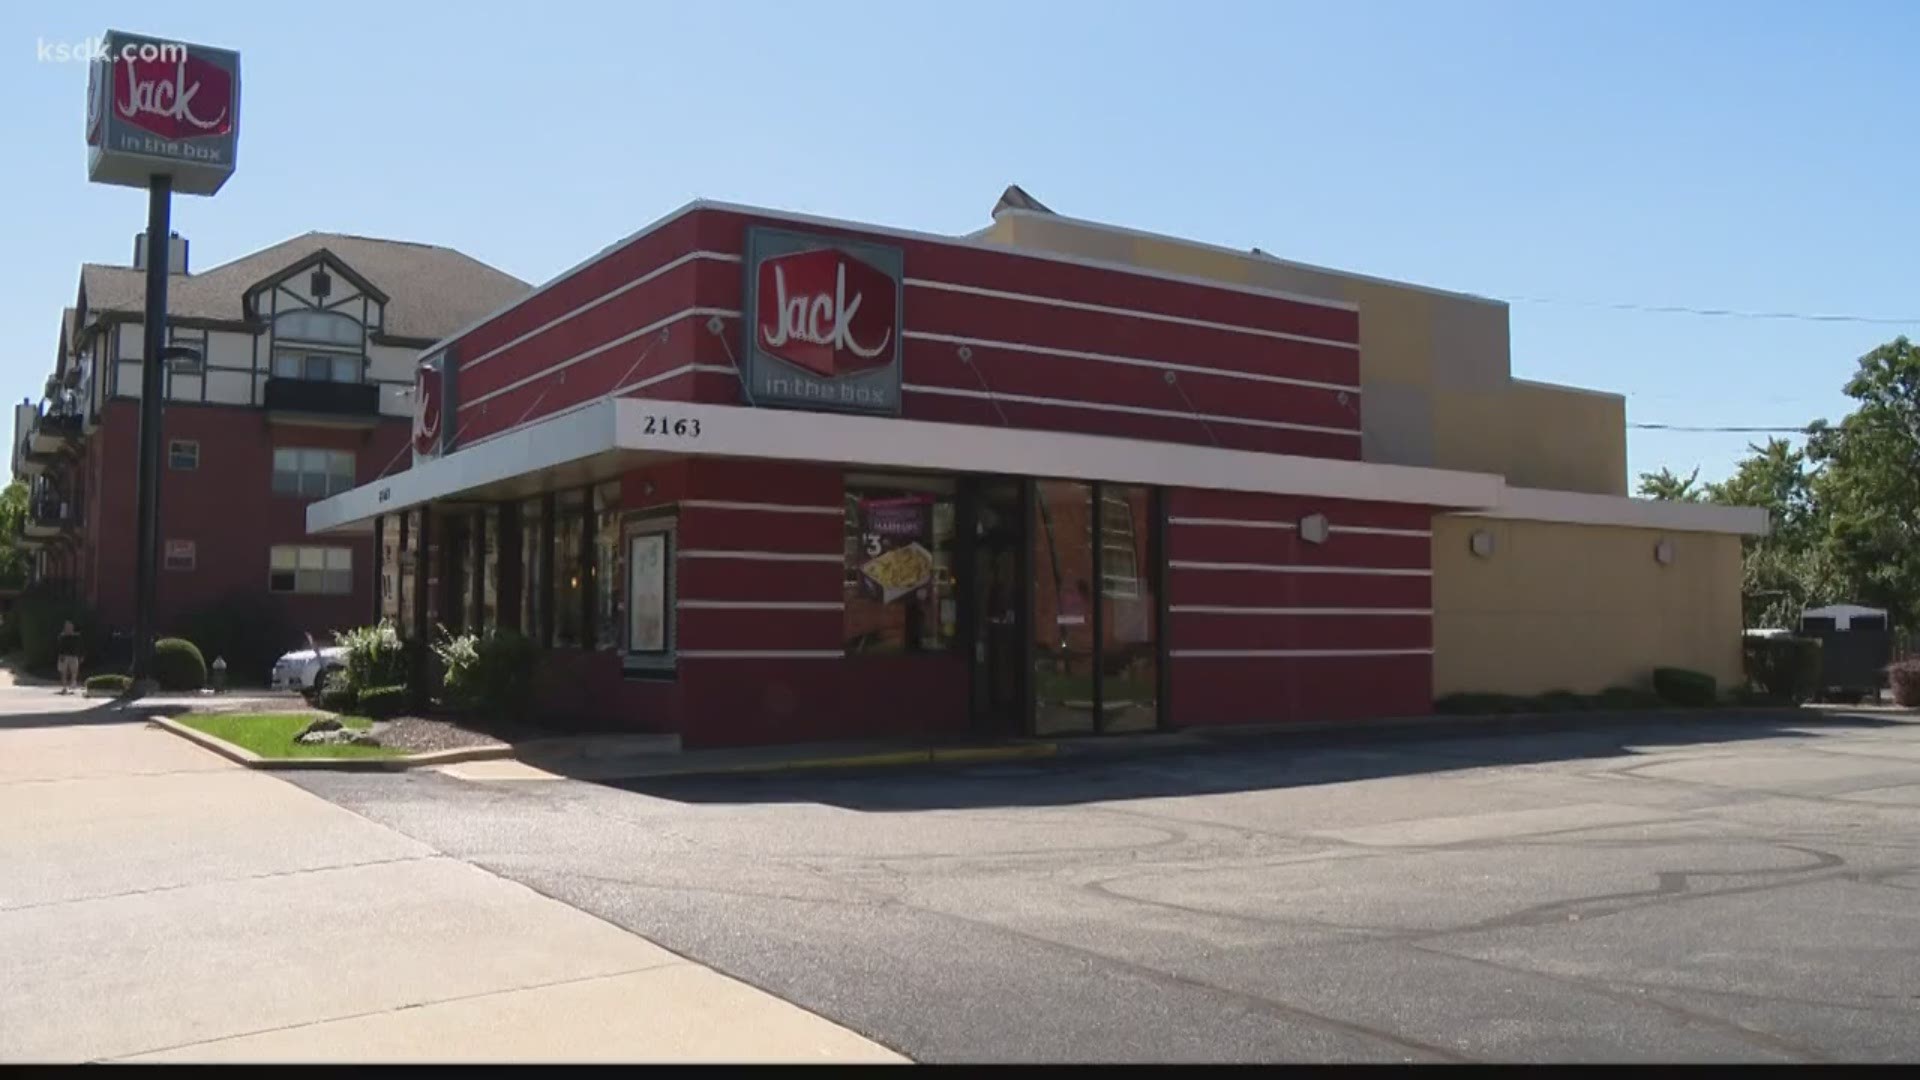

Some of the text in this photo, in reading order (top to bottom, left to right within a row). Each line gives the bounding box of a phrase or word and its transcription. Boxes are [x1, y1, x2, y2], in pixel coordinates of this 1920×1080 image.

[117, 58, 227, 129] Jack
[120, 133, 221, 161] in the box
[763, 261, 892, 358] Jack
[766, 378, 885, 405] in the box
[643, 415, 701, 438] 2163
